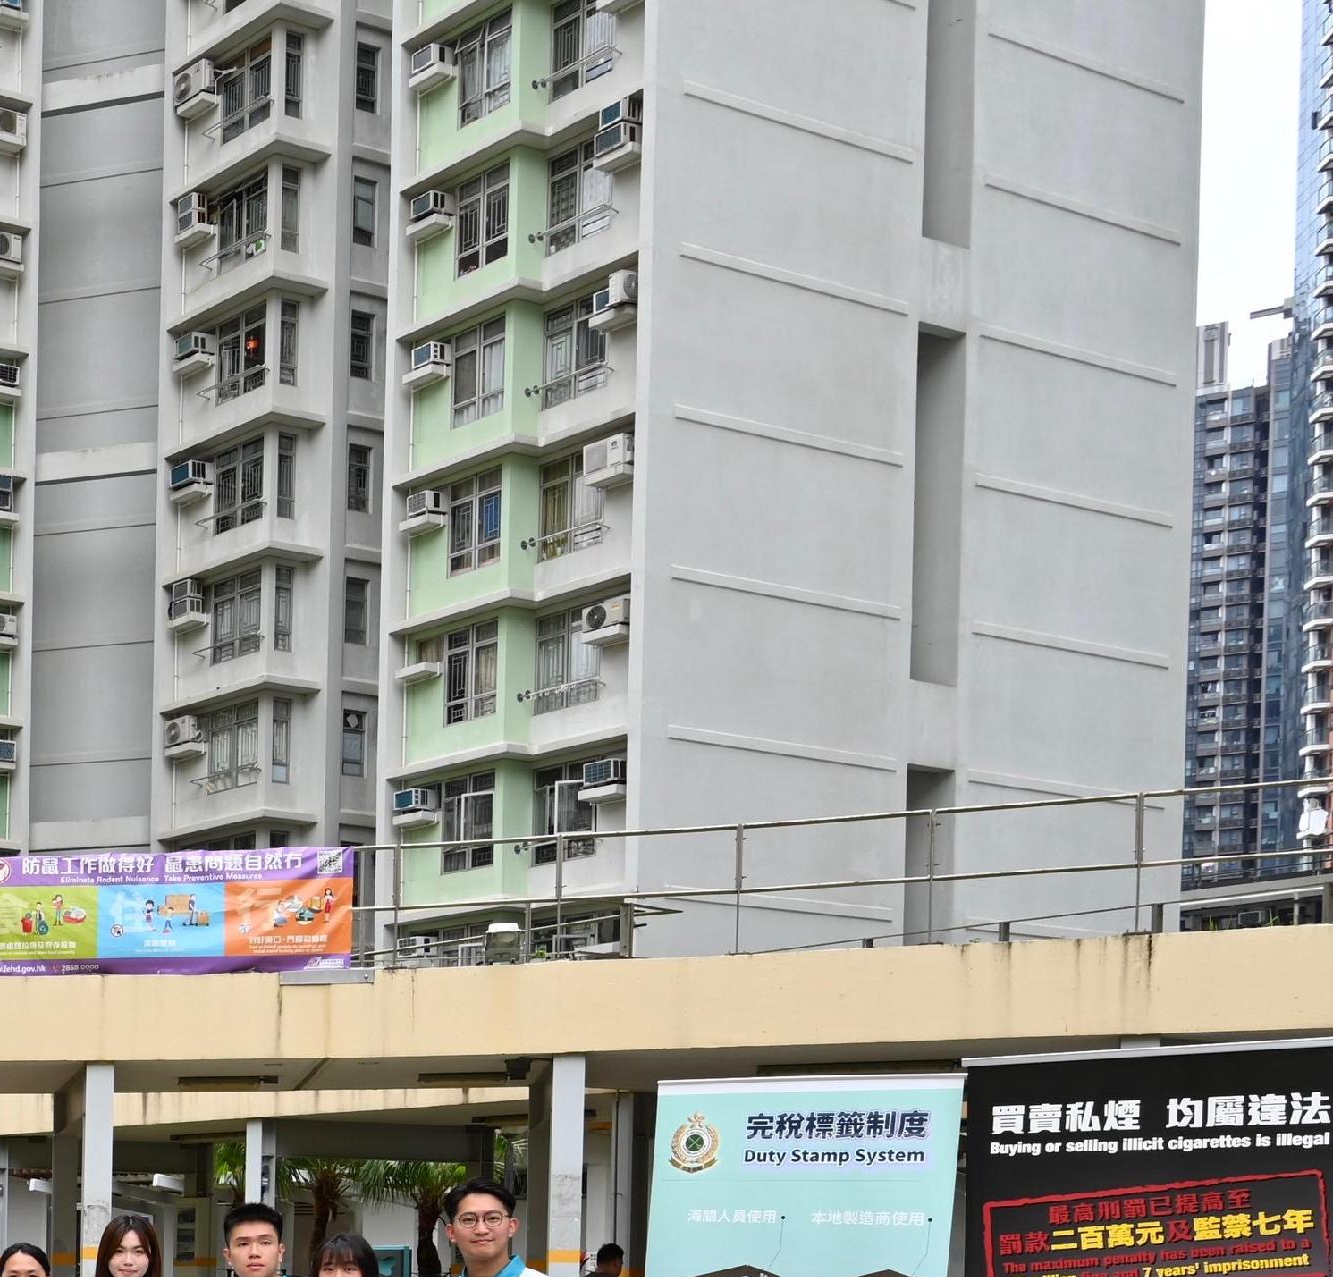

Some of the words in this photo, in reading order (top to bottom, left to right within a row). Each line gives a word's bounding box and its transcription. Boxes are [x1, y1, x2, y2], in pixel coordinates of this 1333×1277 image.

[22, 854, 154, 876] 防鼠工作做得好
[164, 852, 303, 873] 鼠患問題自然冇
[746, 1110, 930, 1141] 完稅標籤制度
[991, 1099, 1141, 1135] 買賣私煙
[1165, 1091, 1332, 1129] 均屬違法
[744, 1148, 787, 1167] Duty
[791, 1148, 849, 1167] Stamp
[855, 1148, 926, 1166] System
[990, 1140, 1041, 1156] Buying
[1044, 1141, 1062, 1154] or
[1066, 1138, 1119, 1155] selling
[1122, 1136, 1164, 1152] illicit
[1167, 1134, 1252, 1152] cigarettes
[1255, 1133, 1271, 1147] is
[1276, 1132, 1331, 1151] illegal
[687, 1208, 777, 1224] 海關人員使用
[812, 1210, 926, 1227] 本地製造商使用
[1048, 1188, 1252, 1226] 最高刑罰已提高至
[999, 1208, 1315, 1257] 罰款二百萬元及監禁七年
[1002, 1261, 1027, 1274] The
[1031, 1256, 1100, 1272] maximum
[1160, 1249, 1187, 1261] has
[1231, 1240, 1278, 1256] raised
[1281, 1240, 1296, 1251] to
[1301, 1240, 1312, 1250] a
[1204, 1254, 1311, 1275] imprisonment
